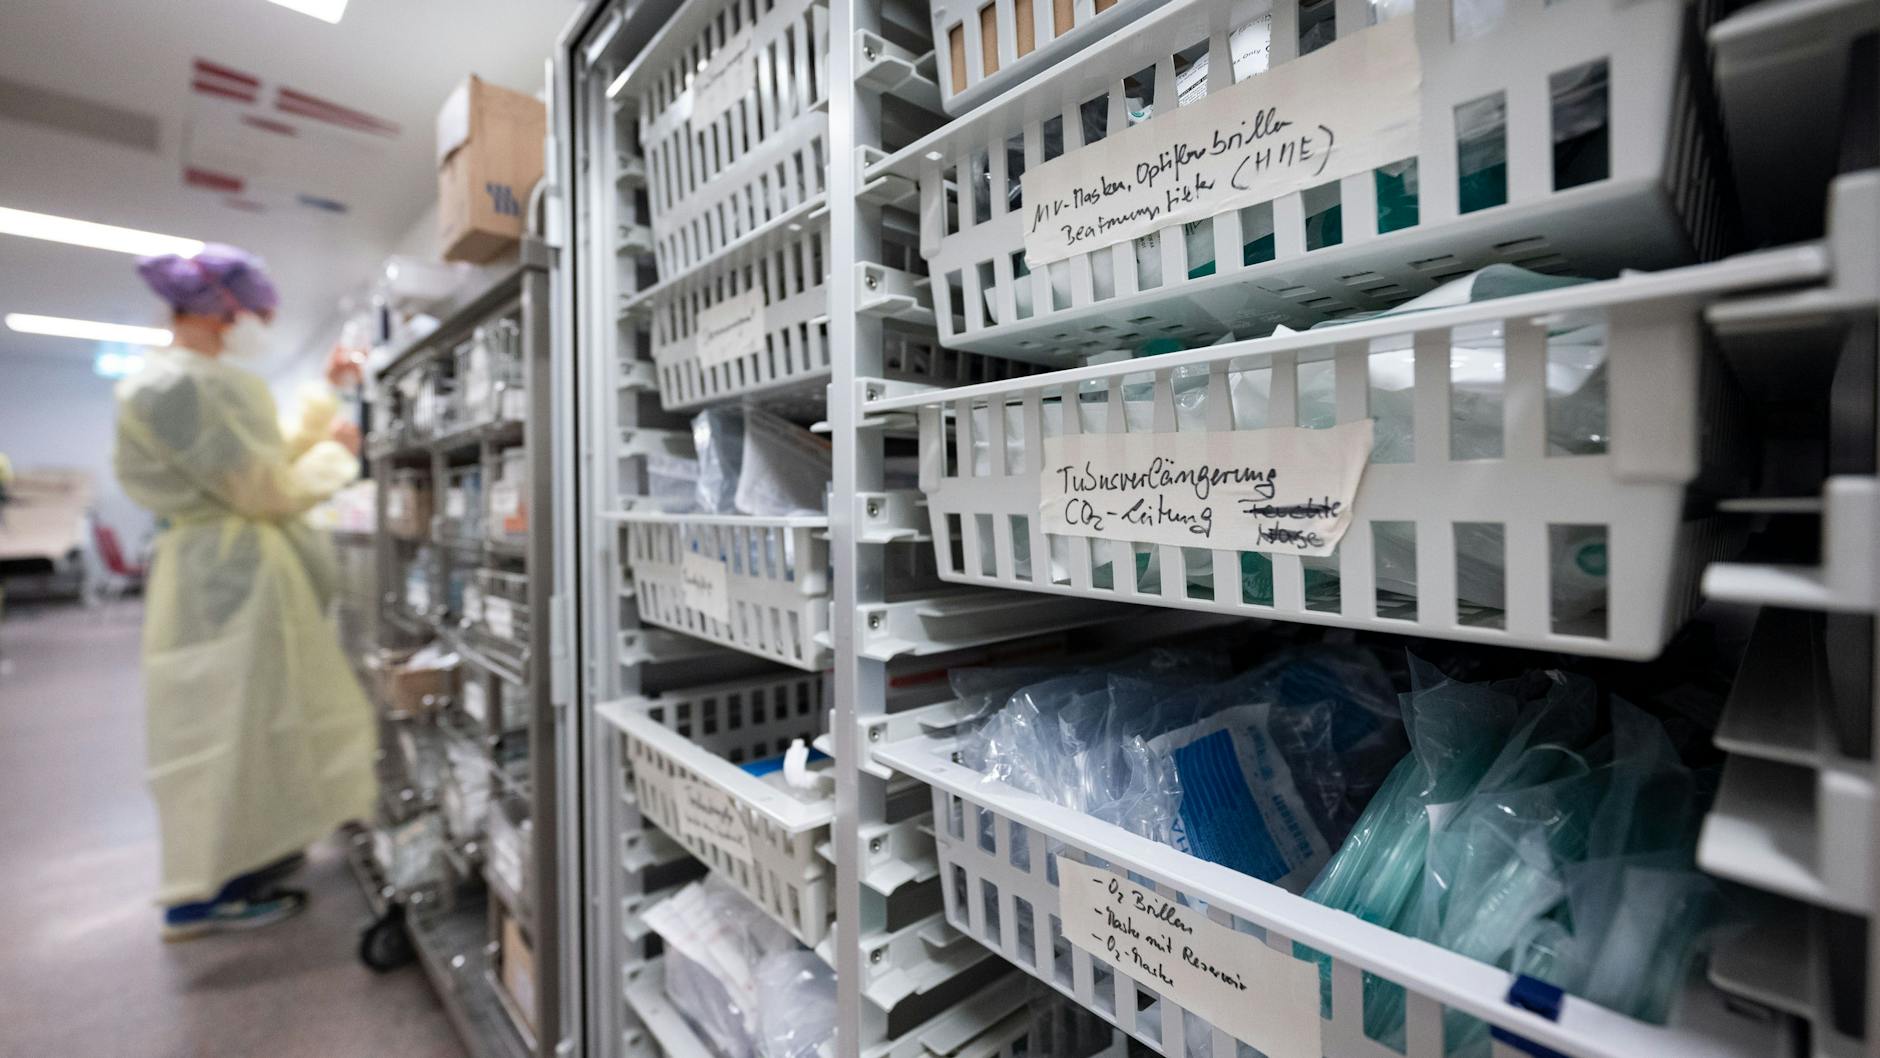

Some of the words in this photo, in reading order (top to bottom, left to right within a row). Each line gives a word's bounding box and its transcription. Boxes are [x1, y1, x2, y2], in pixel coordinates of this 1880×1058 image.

[1231, 125, 1334, 191] (HME)
[1056, 457, 1278, 500] Tubusverlängerung
[1131, 890, 1193, 935] Brillen
[1145, 934, 1172, 954] mit
[1182, 946, 1248, 991] Reservoir
